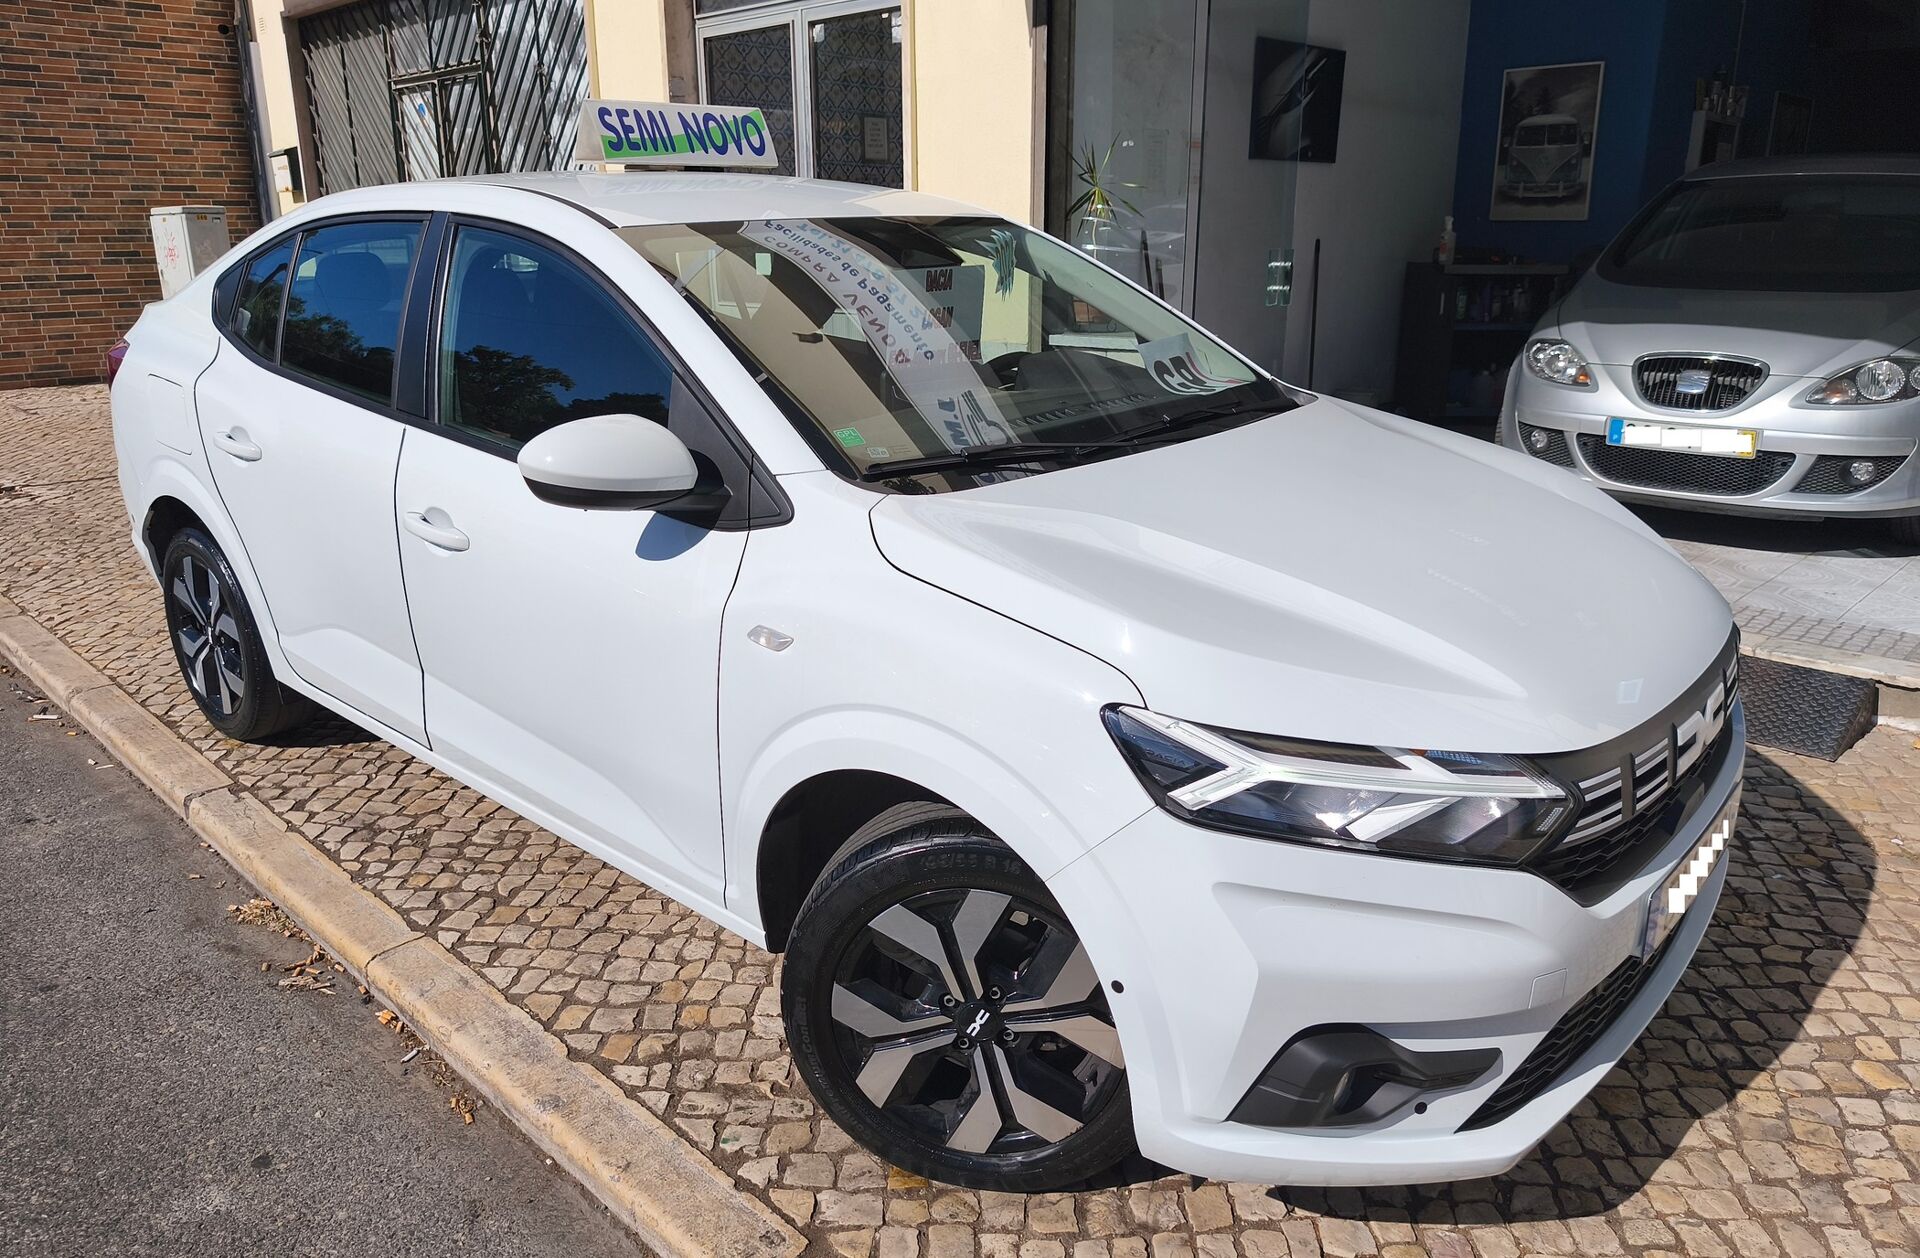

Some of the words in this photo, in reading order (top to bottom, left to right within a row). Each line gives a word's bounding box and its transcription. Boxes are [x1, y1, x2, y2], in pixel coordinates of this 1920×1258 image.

[598, 106, 677, 152] SEMI
[678, 111, 766, 157] NOVO
[925, 268, 954, 293] DACIA
[837, 426, 859, 438] GPL
